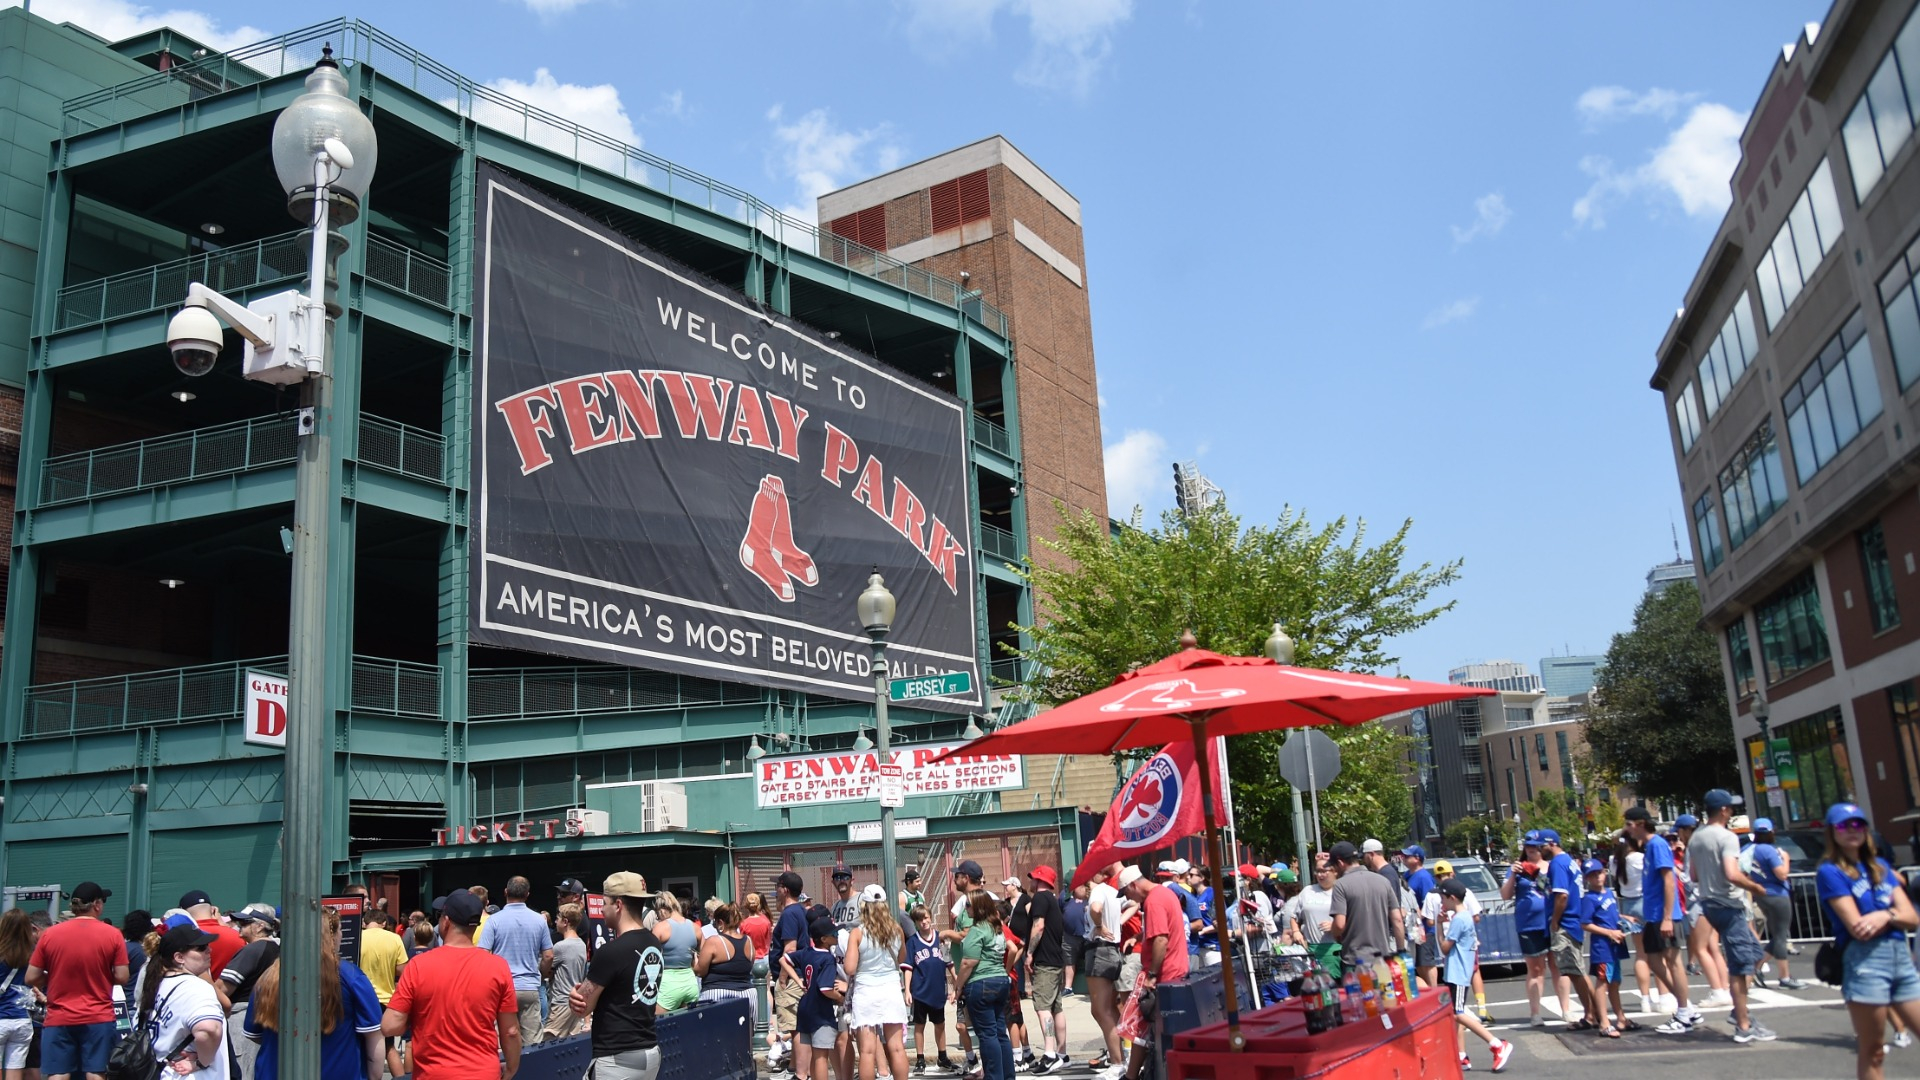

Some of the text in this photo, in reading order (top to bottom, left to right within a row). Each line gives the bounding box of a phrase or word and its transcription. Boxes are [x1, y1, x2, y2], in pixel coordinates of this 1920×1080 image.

[656, 297, 867, 410] WELCOME TO
[495, 369, 966, 596] FENWAY PARK
[496, 581, 675, 644] AMERICA'S
[685, 620, 763, 658] MOST
[771, 636, 870, 677] BELOVED
[902, 678, 957, 699] JERSEY ST
[255, 698, 287, 737] D
[760, 782, 790, 794] GATE
[794, 781, 802, 790] D
[807, 777, 847, 789] STAIRS
[927, 769, 950, 780] ALL
[955, 762, 1017, 777] SECTIONS
[772, 791, 819, 803] JERSEY
[824, 786, 871, 799] STREET
[916, 780, 949, 792] NESS
[955, 775, 1004, 789] STREET
[431, 818, 585, 847] TICKETS
